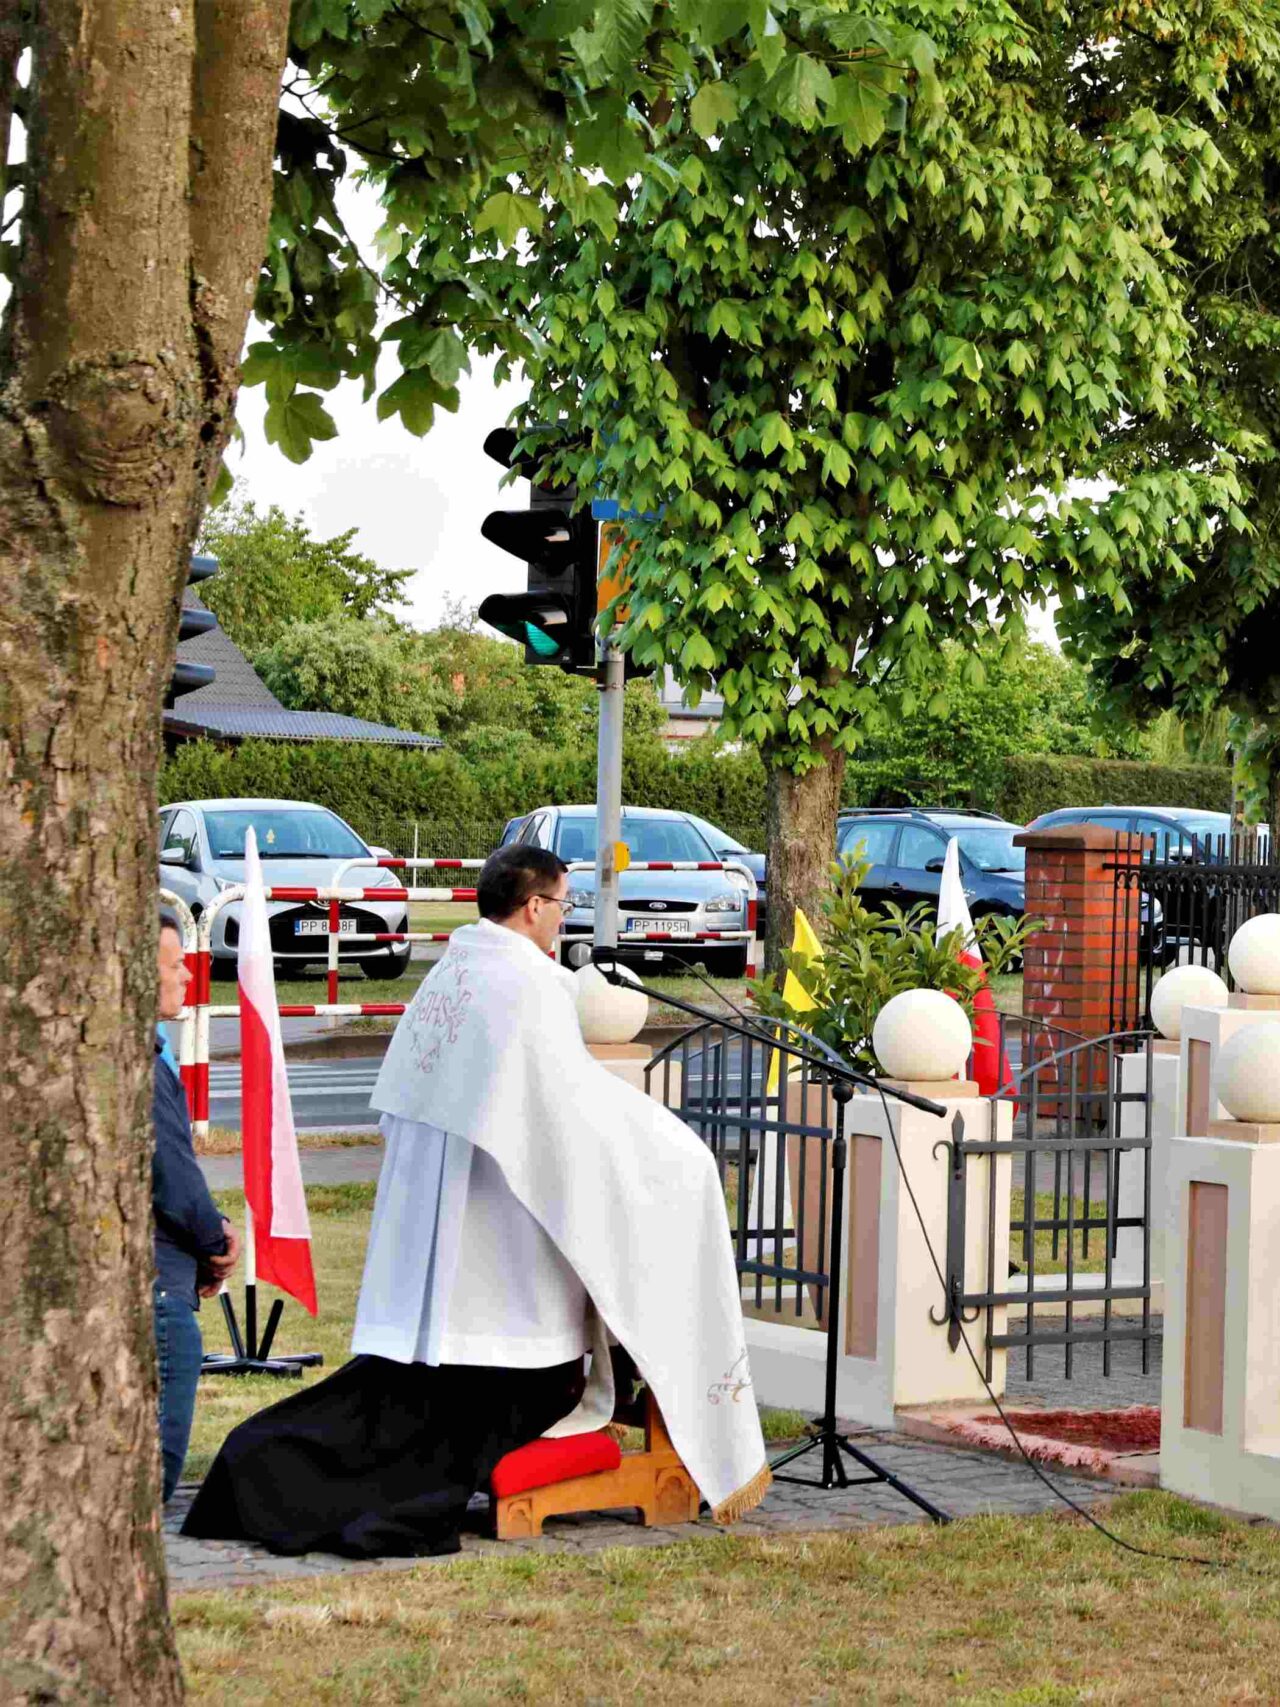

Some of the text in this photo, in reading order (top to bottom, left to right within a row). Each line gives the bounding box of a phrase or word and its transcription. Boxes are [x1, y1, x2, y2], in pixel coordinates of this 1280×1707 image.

[301, 920, 354, 933] PP 88F
[634, 920, 687, 932] PP 1195H
